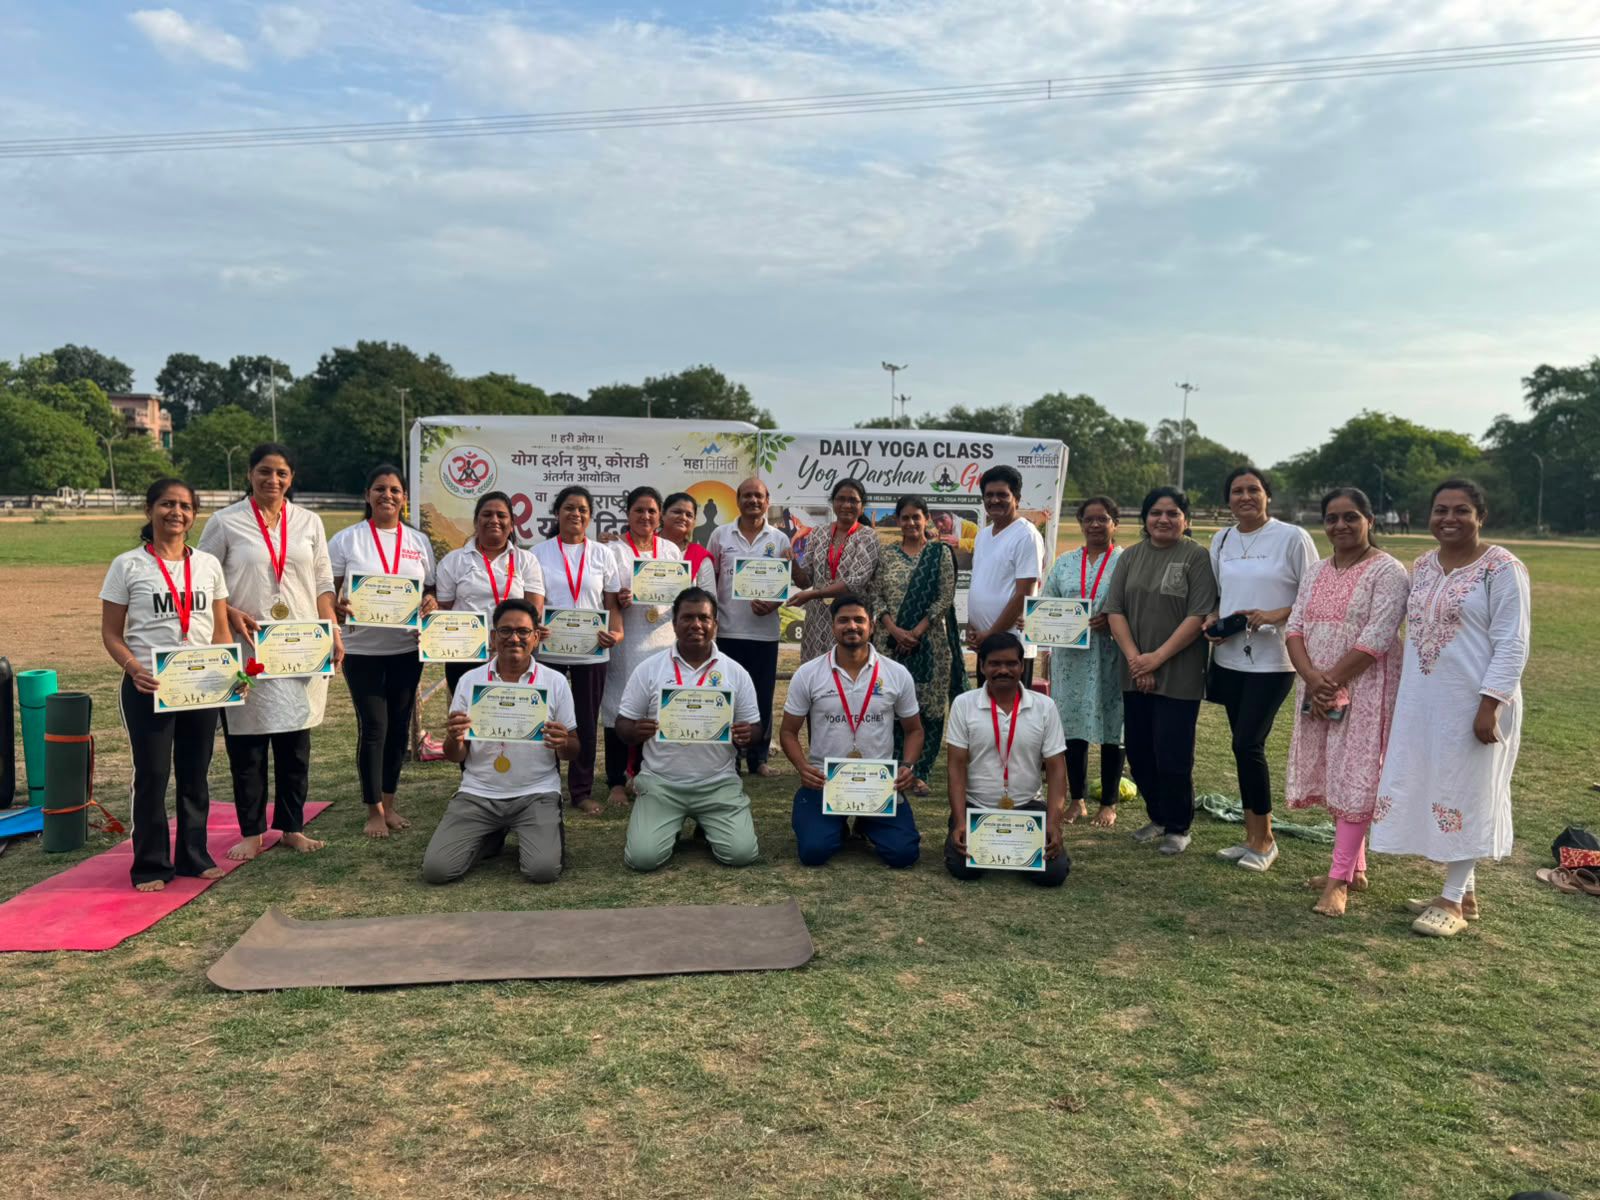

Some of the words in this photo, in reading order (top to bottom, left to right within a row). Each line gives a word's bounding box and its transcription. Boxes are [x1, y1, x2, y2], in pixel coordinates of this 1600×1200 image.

[560, 432, 575, 444] हरी
[577, 432, 595, 444] ओम
[819, 439, 872, 457] DAILY
[878, 440, 929, 458] YOGA
[932, 441, 994, 459] CLASS
[511, 450, 538, 466] योग
[541, 450, 574, 467] दर्शन
[577, 454, 602, 471] ग्रुप,
[605, 451, 650, 468] कोराडी
[543, 470, 574, 482] अंतर्गत
[577, 470, 621, 483] आयोजित
[798, 454, 839, 491] Yog
[846, 458, 927, 486] Darshan
[535, 491, 548, 502] वा
[153, 591, 207, 614] MND
[825, 714, 847, 724] YOGA
